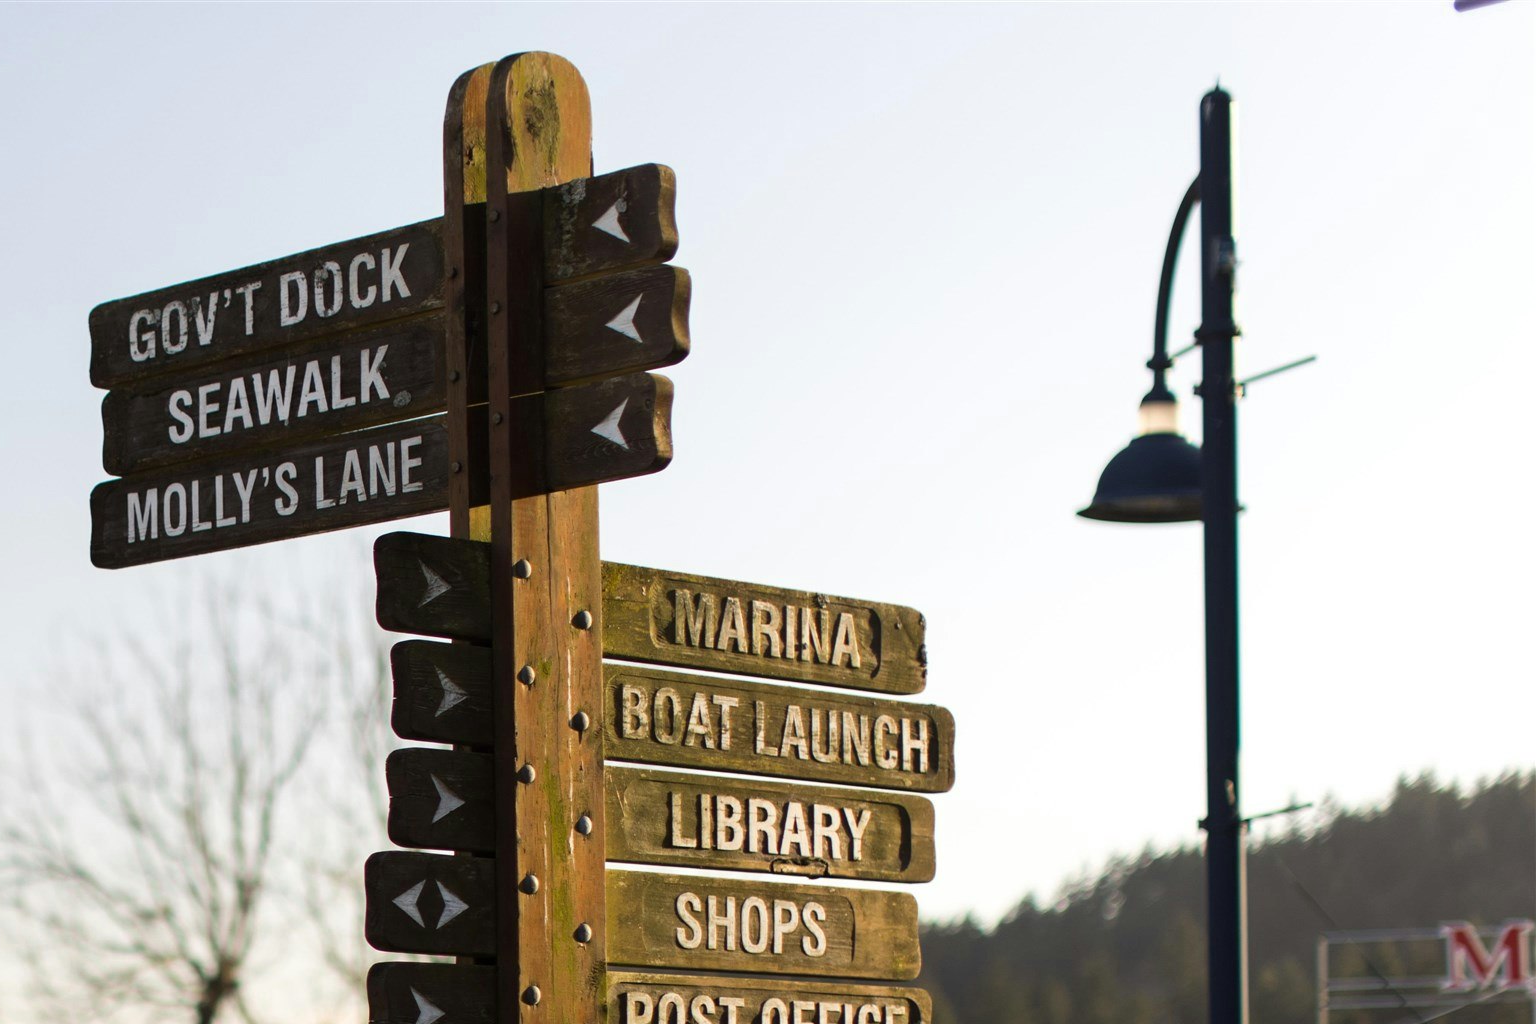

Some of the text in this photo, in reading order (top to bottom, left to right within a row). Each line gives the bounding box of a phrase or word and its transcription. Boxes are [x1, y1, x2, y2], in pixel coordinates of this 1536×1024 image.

[128, 242, 412, 363] GOV'T DOCK
[167, 343, 391, 444] SEAWALK
[125, 435, 424, 544] MOLLY'S LANE
[672, 588, 862, 669] MARINA
[621, 683, 929, 774] BOAT LAUNCH
[670, 790, 872, 862] LIBRARY
[675, 891, 827, 958] SHOPS
